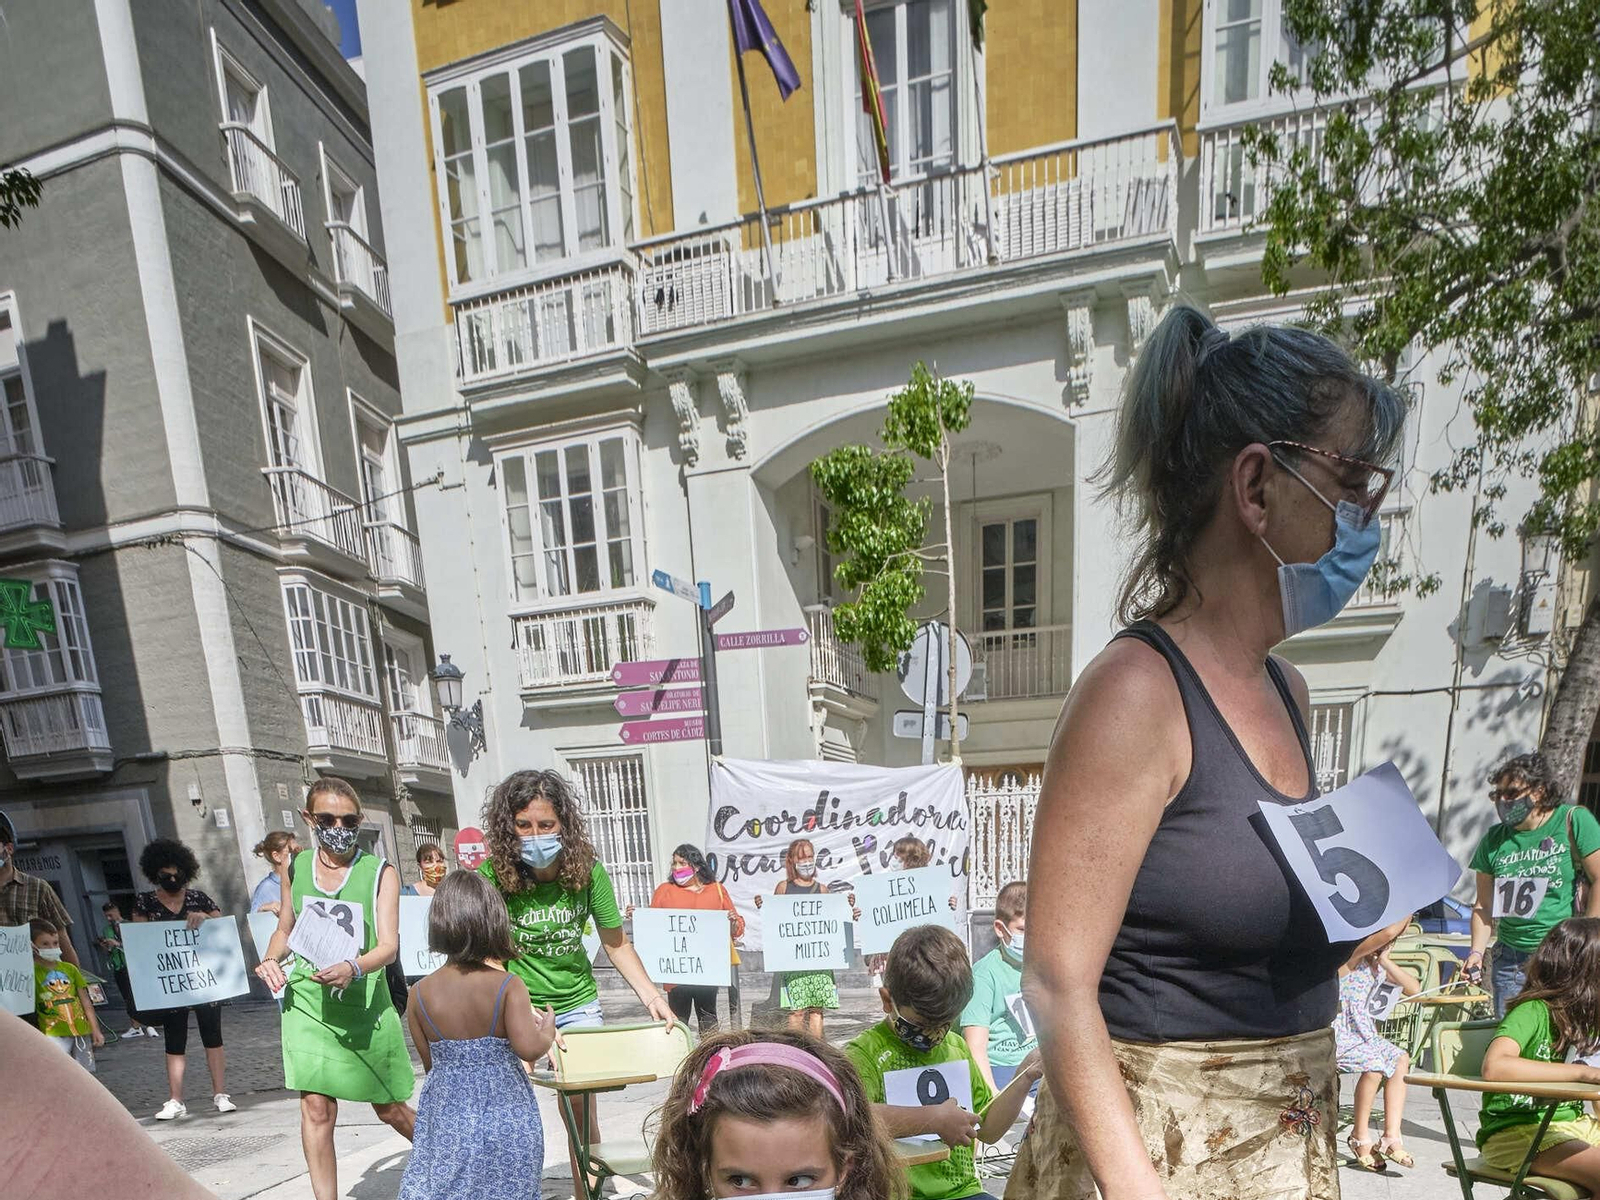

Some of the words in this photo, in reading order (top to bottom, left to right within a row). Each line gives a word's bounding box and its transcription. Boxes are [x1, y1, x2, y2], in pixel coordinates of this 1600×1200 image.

[720, 635, 745, 647] CALLE
[745, 631, 785, 645] ZORRILLA
[682, 697, 702, 709] NERI
[643, 731, 670, 740] CORTES
[670, 729, 681, 739] DE
[681, 727, 704, 738] CÁDIZ
[714, 790, 967, 843] Coordinadora
[1287, 804, 1390, 929] 5
[1498, 880, 1537, 916] 16
[872, 895, 937, 927] COLUMELA
[779, 919, 838, 938] CELESTINO
[673, 936, 688, 953] LA
[796, 941, 830, 960] MUTIS
[157, 950, 200, 972] SANTA
[659, 957, 704, 974] CALETA
[157, 969, 217, 994] TERESA
[1368, 983, 1395, 1016] 5
